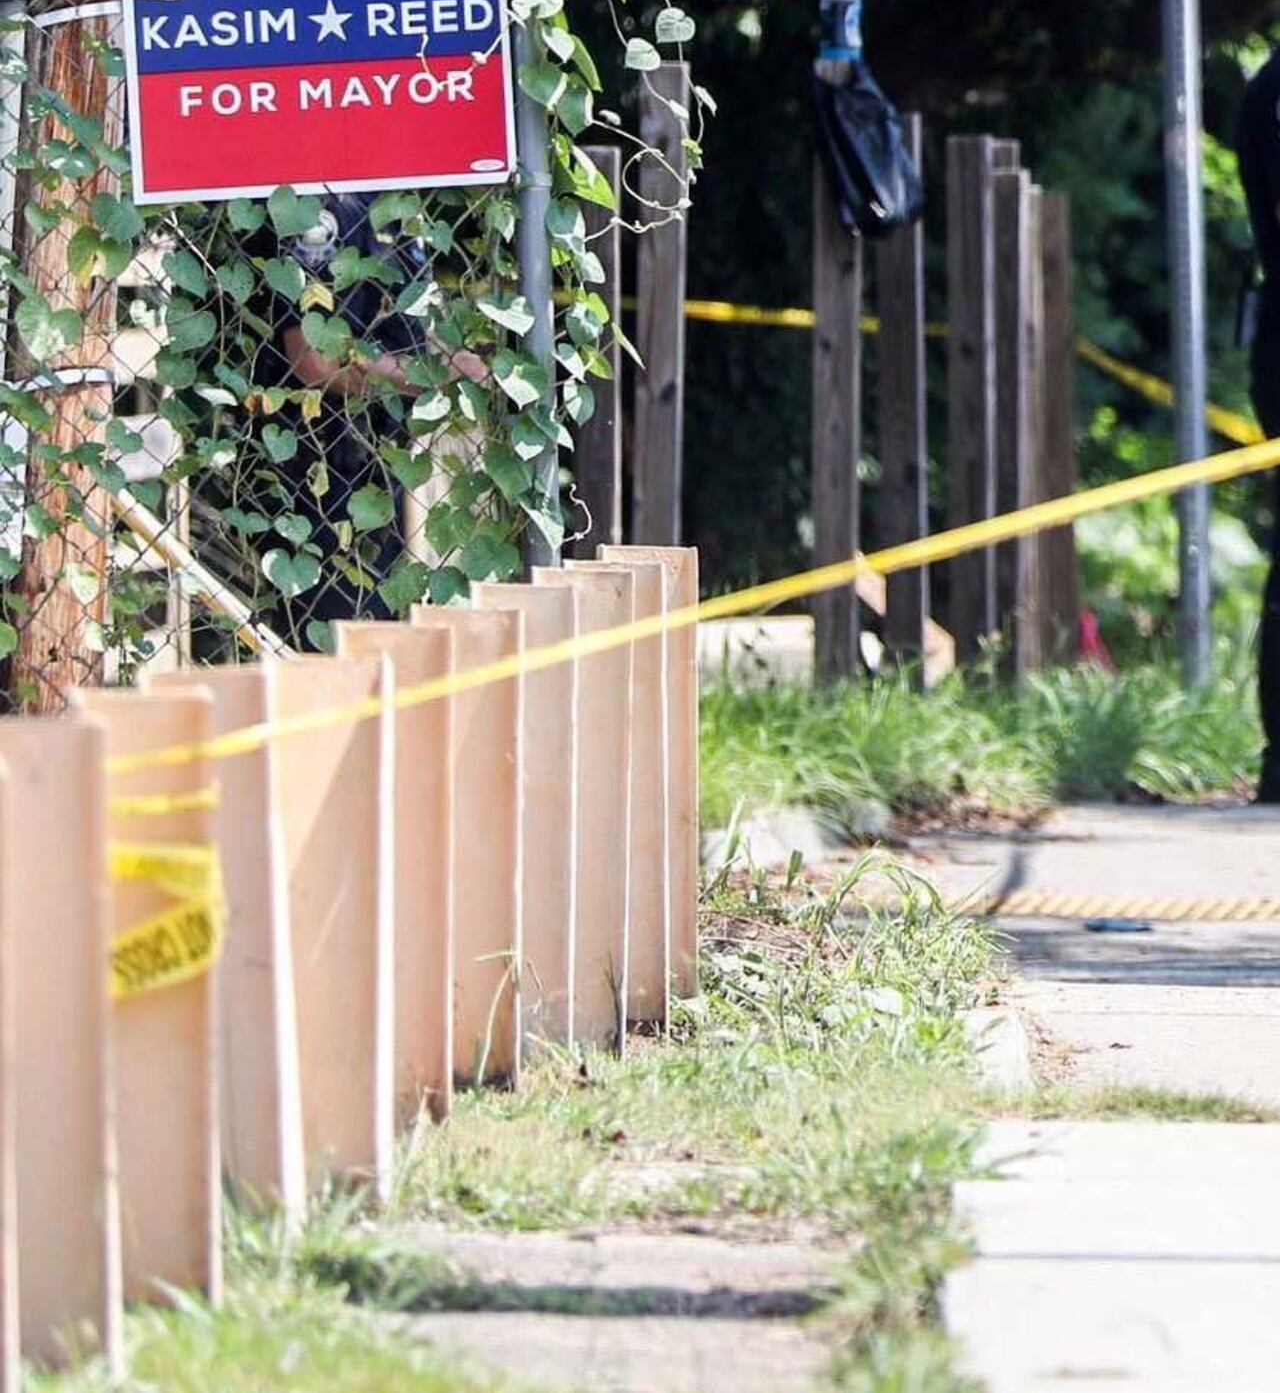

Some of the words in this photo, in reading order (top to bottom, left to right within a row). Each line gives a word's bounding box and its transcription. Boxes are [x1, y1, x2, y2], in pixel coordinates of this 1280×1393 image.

[142, 7, 296, 50] KASIM
[179, 81, 277, 117] FOR
[300, 70, 475, 110] MAYOR
